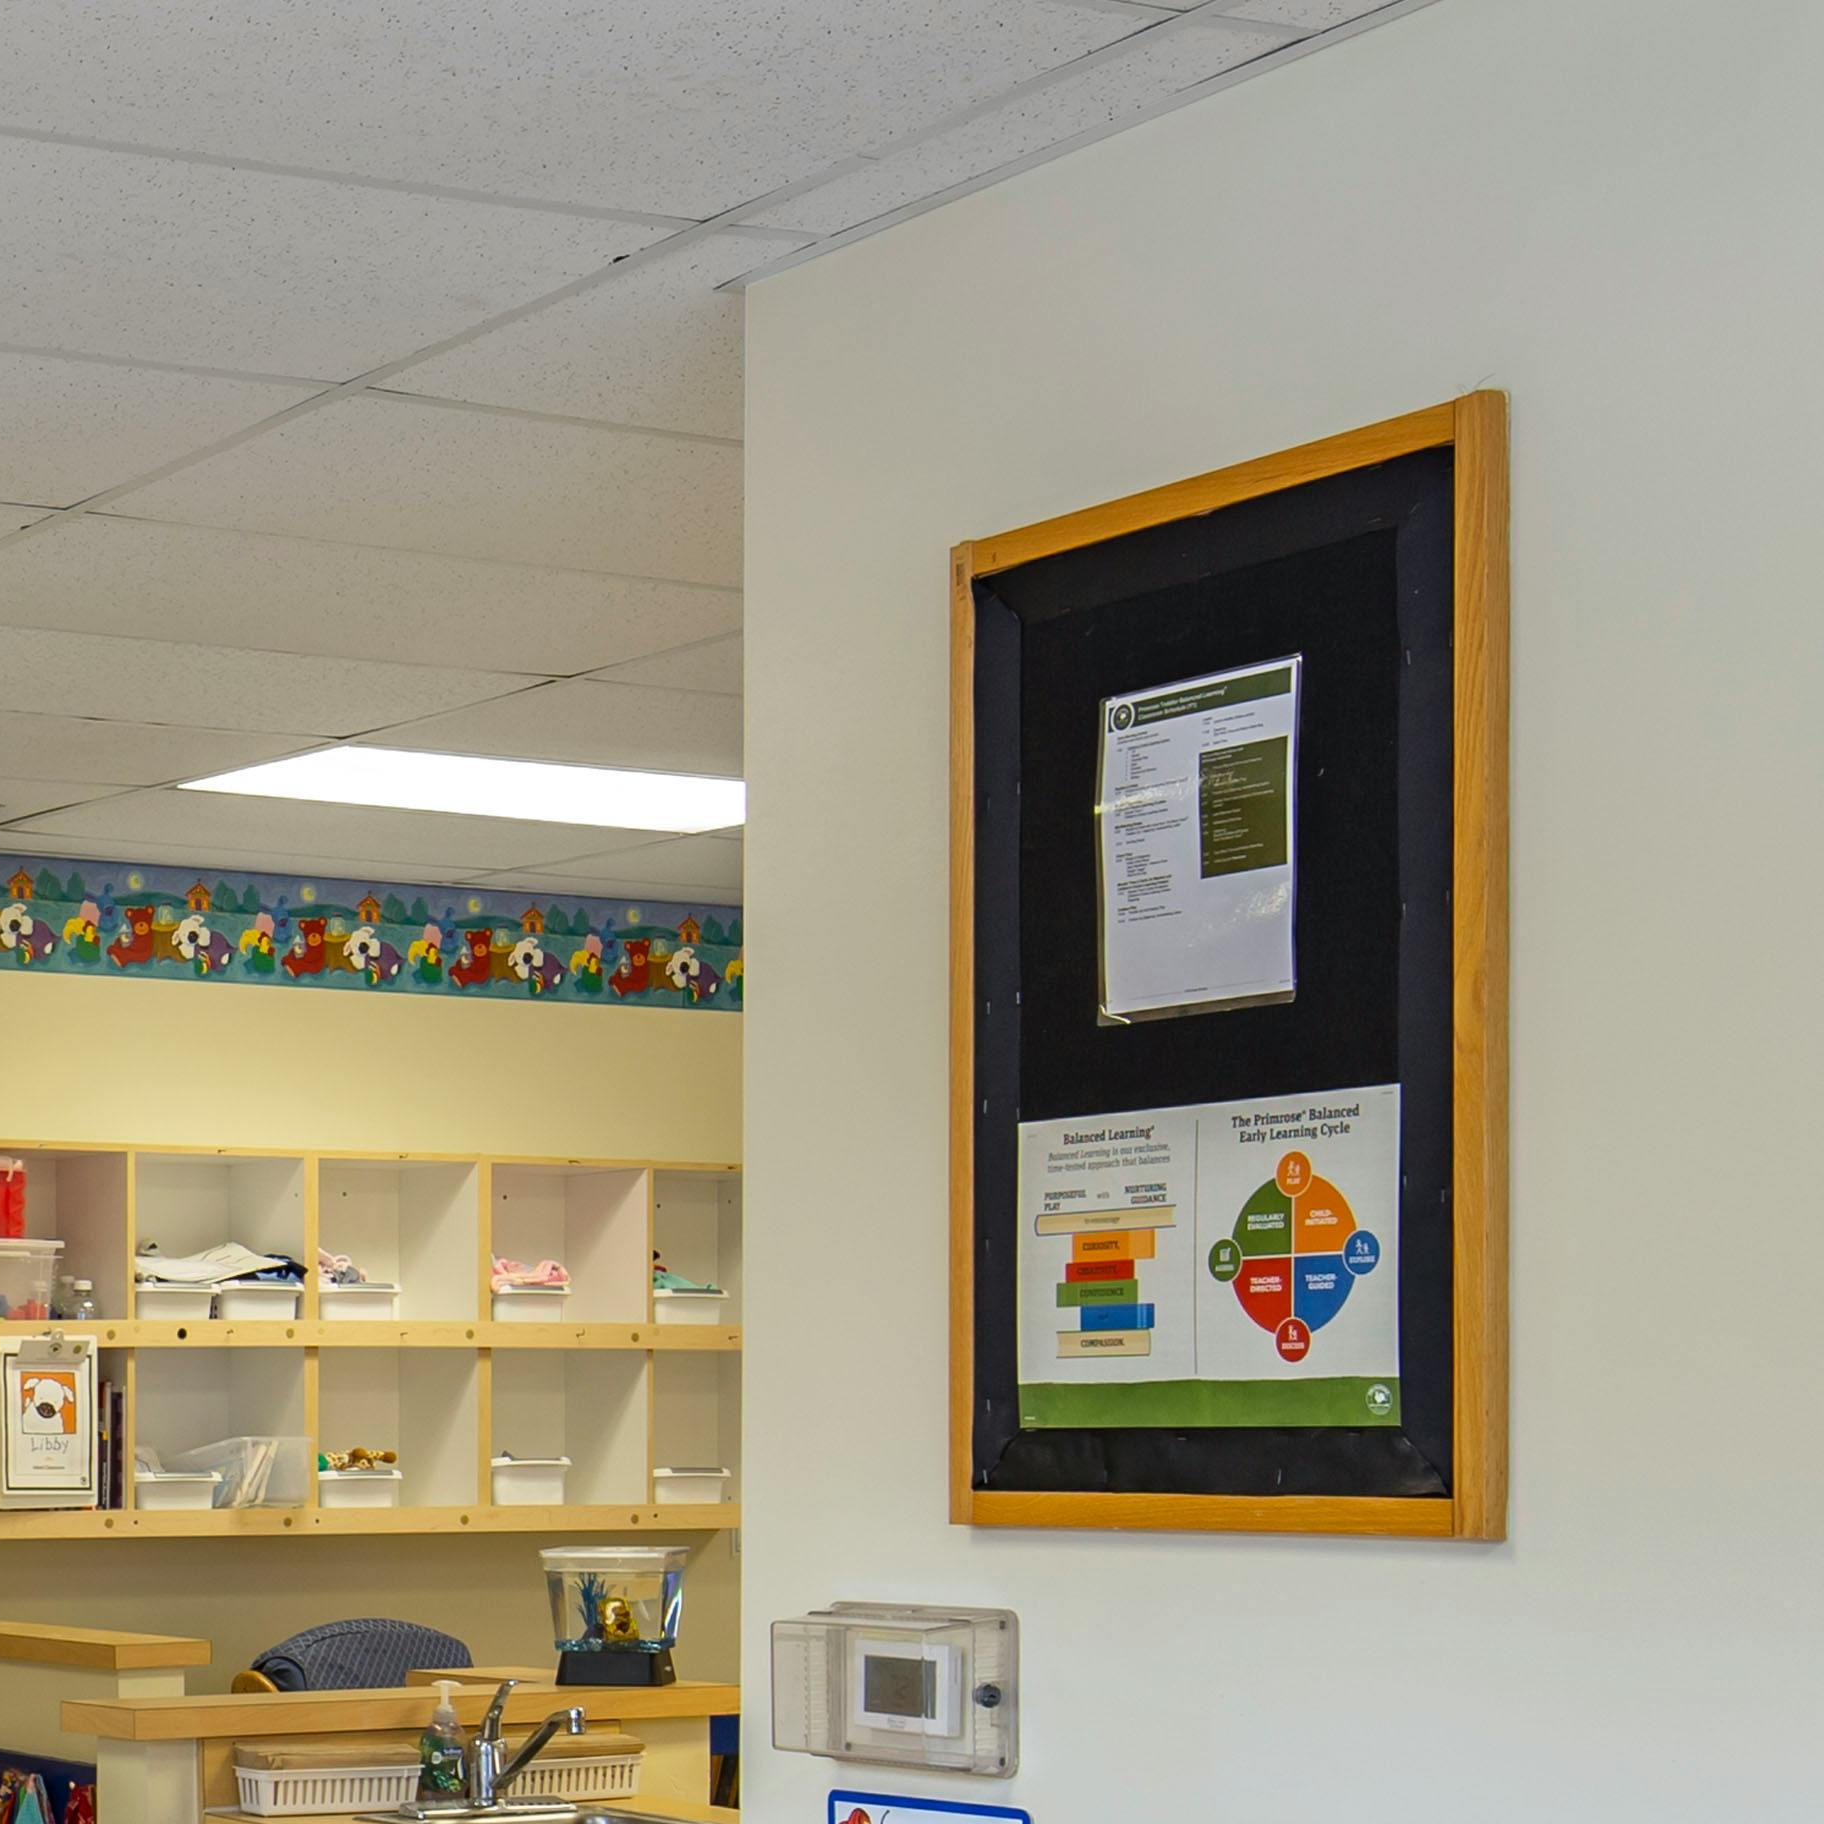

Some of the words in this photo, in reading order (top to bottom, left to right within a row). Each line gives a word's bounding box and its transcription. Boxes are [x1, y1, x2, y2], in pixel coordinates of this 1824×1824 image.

[1231, 1115, 1251, 1128] The
[1309, 1104, 1360, 1121] Balanced
[1063, 1130, 1106, 1145] Balanced
[1239, 1130, 1267, 1143] Early
[1269, 1125, 1318, 1140] Learning
[1320, 1122, 1350, 1138] Cycle
[1044, 1202, 1060, 1211] PLAY
[30, 1436, 69, 1454] Libby
